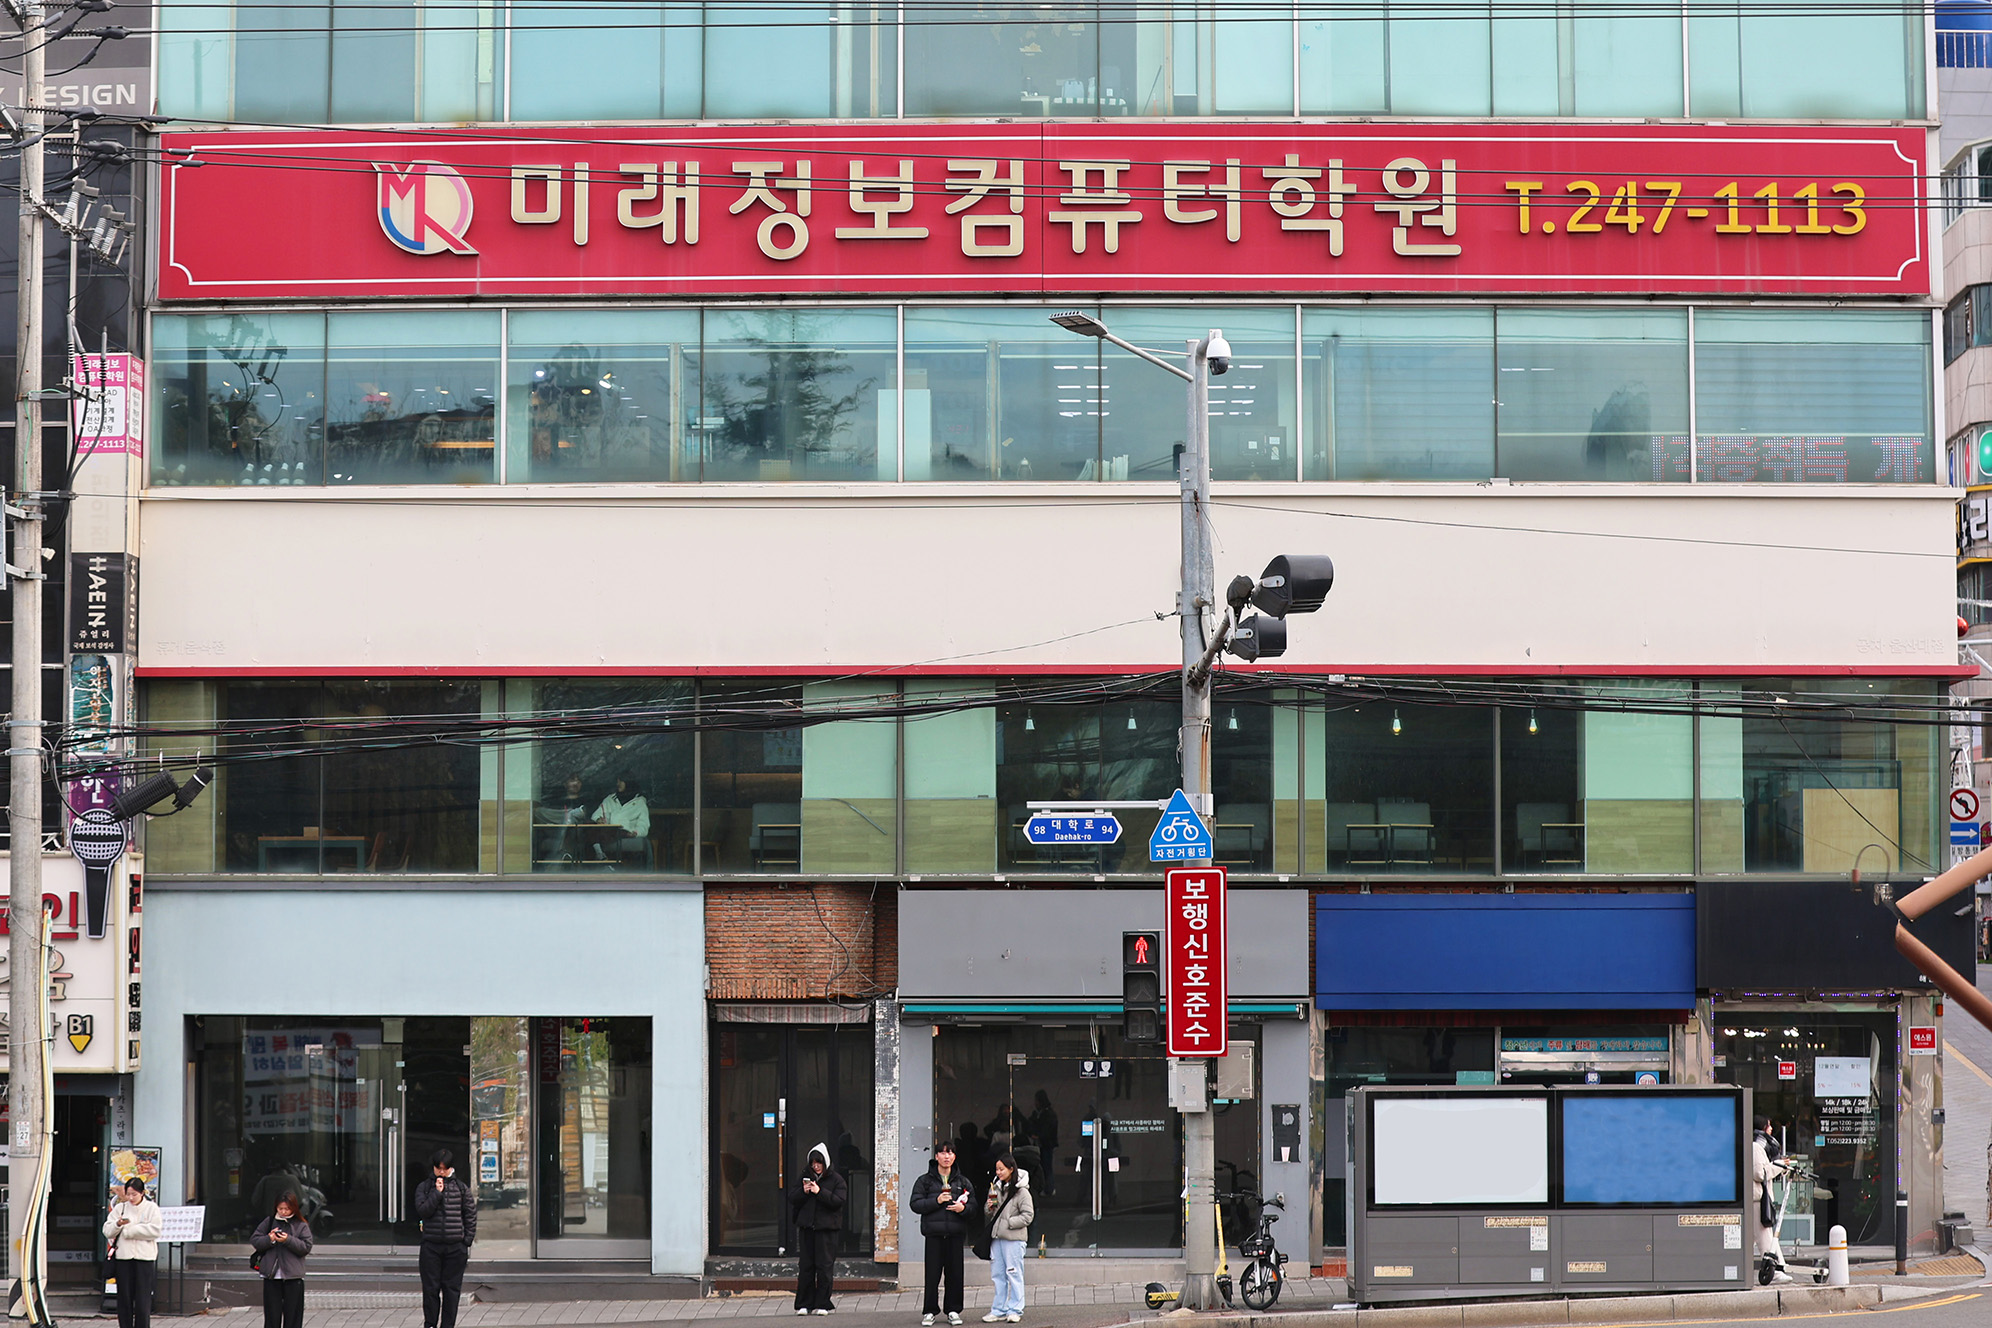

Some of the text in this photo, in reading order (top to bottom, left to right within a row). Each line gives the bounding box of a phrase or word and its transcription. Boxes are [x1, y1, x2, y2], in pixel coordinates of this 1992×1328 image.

[18, 84, 136, 107] ESIGN
[509, 153, 1868, 262] 미래정보컴퓨터학원 T.247-1113
[88, 556, 107, 628] HAEIN
[1034, 825, 1046, 835] 98
[1051, 819, 1095, 831] 대학로
[1101, 824, 1114, 834] 94
[1055, 833, 1092, 841] Daehak-ro
[1155, 846, 1207, 858] 자전거횡단
[1182, 878, 1210, 1045] 보행신호준수
[69, 1015, 92, 1035] B1
